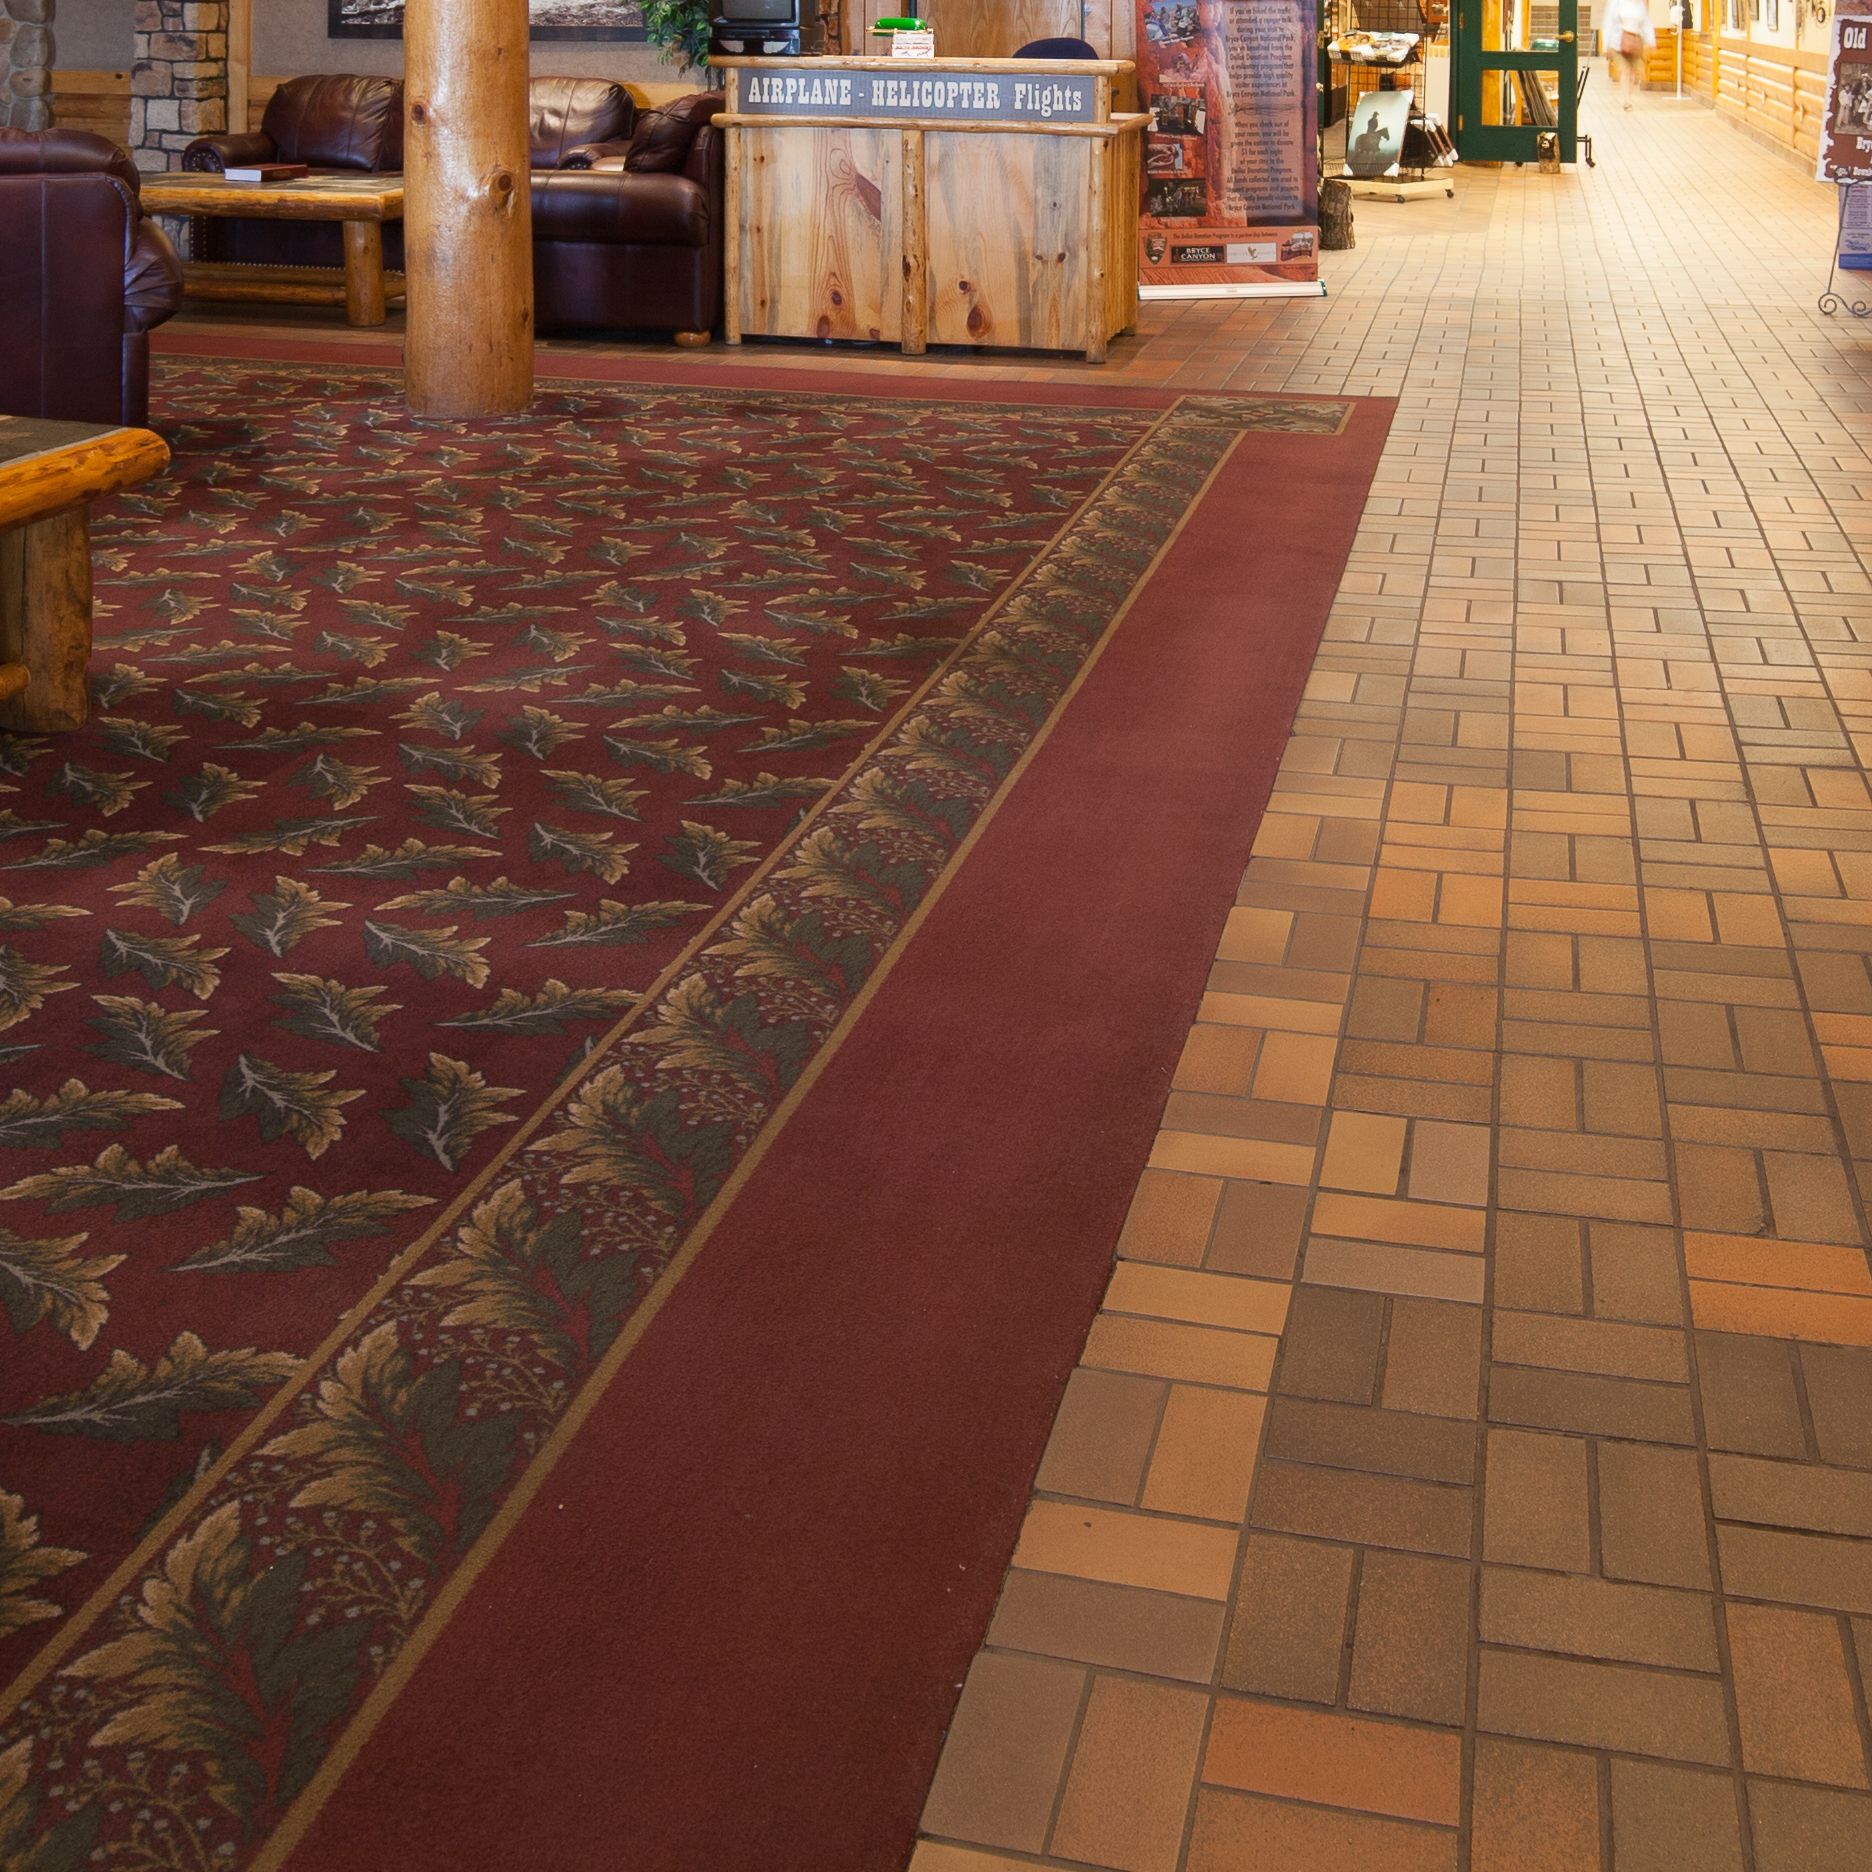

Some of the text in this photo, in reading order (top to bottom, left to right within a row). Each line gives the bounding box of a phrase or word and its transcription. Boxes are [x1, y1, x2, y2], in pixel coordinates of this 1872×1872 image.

[1843, 27, 1867, 49] Old
[748, 77, 851, 106] AIRPLANE
[871, 79, 1001, 110] HELICOPTER
[1014, 82, 1082, 117] Flights
